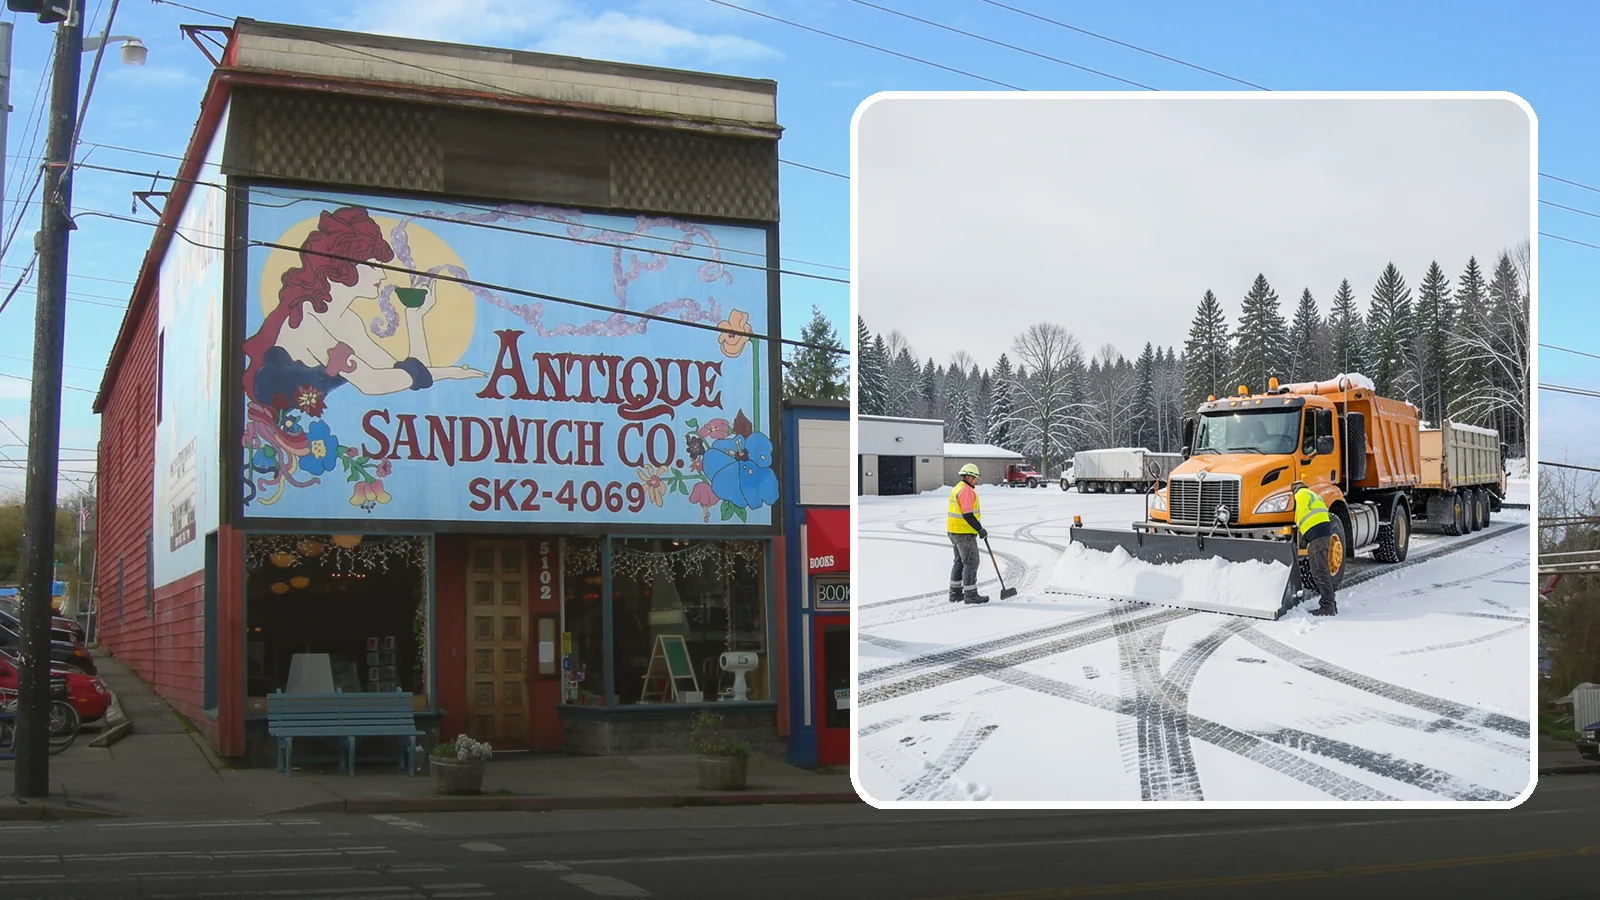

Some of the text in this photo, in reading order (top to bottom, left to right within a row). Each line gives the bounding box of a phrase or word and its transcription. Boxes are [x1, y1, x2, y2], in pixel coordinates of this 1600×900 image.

[477, 329, 723, 420] ANTIQUE
[361, 409, 685, 468] SANDWICH CO.
[468, 477, 645, 512] SK2-4069
[540, 542, 551, 600] 5102
[809, 555, 834, 568] BOOKS
